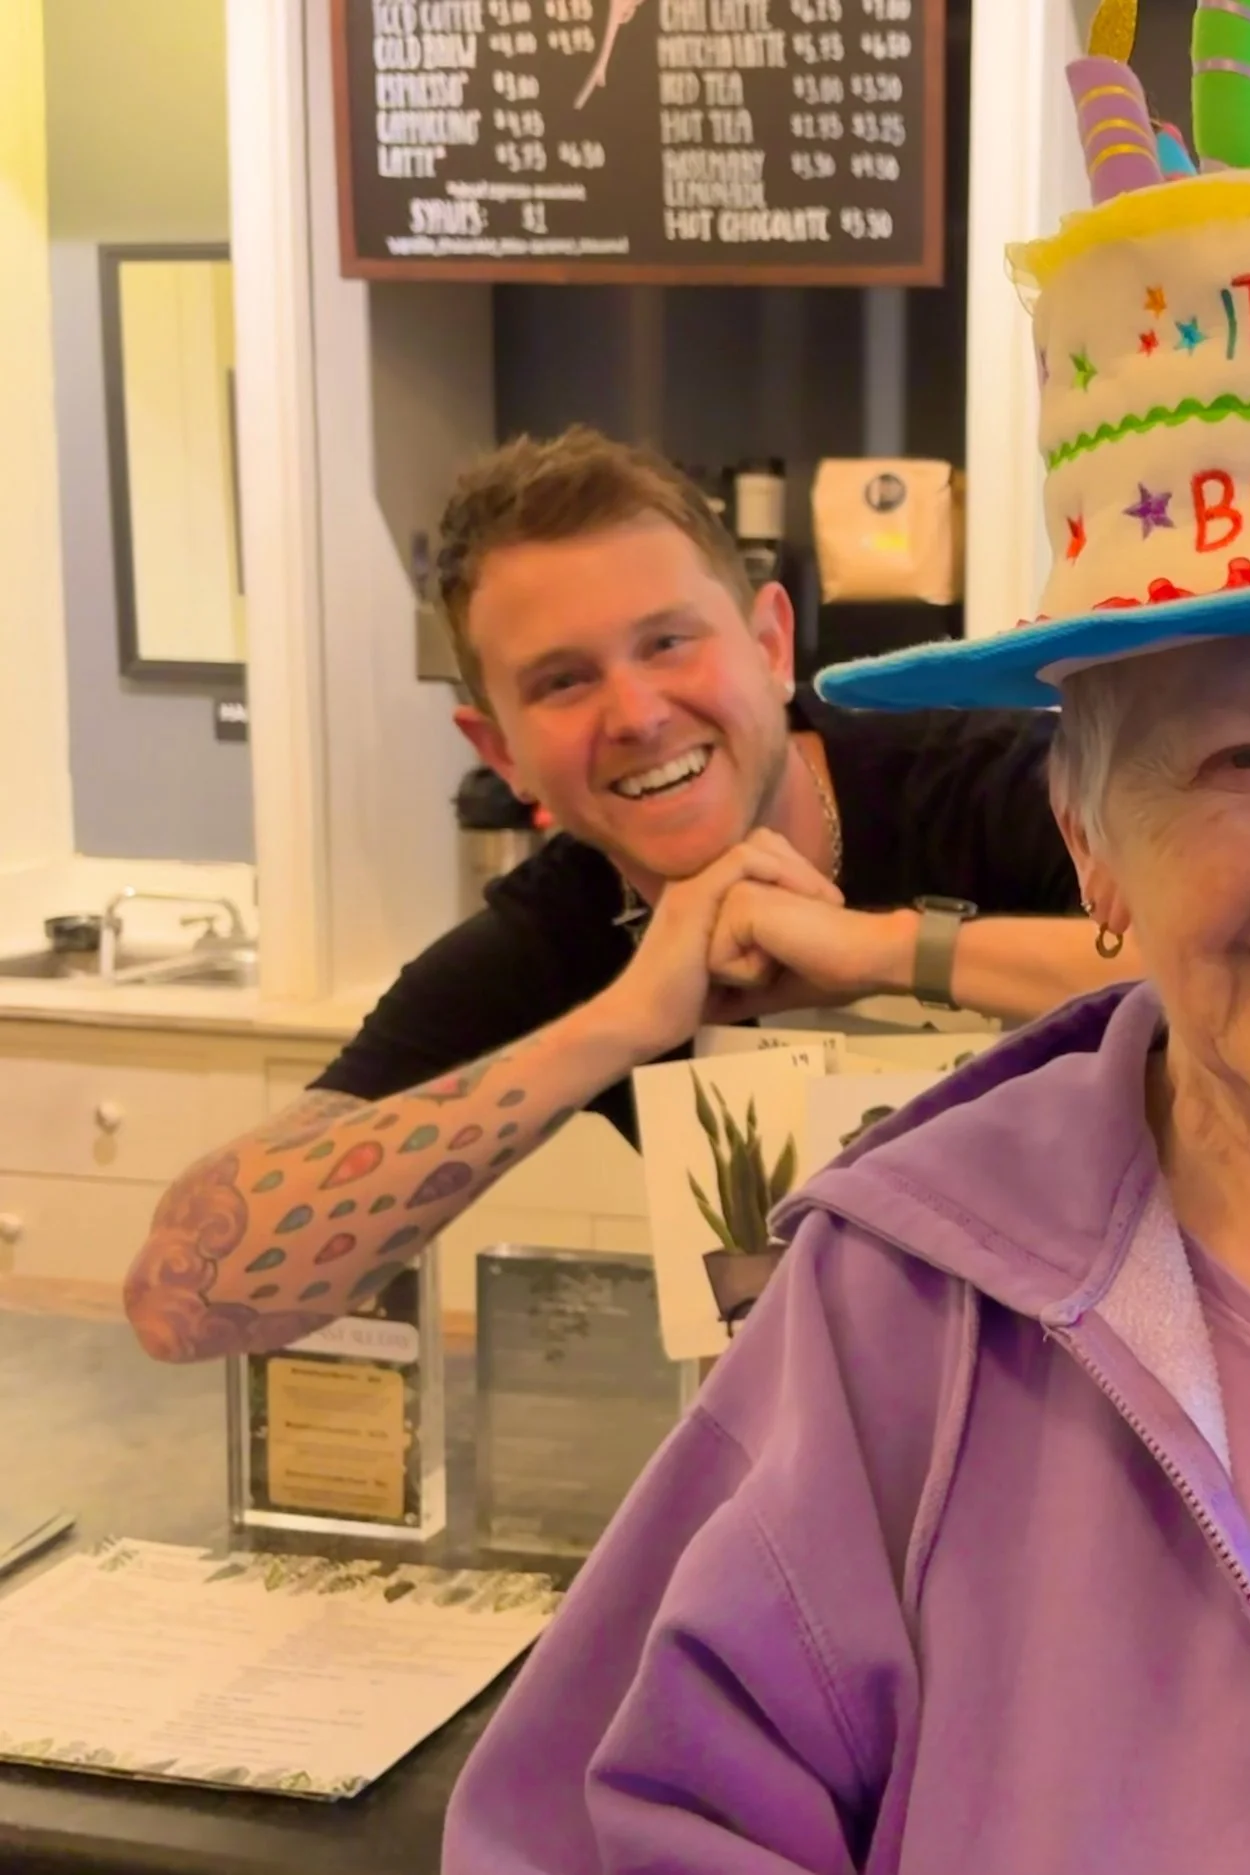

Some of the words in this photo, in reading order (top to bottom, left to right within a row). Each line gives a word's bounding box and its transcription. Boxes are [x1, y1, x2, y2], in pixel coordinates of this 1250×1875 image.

[373, 34, 421, 69] COLD
[422, 33, 477, 68] BREW
[702, 70, 744, 106] TEA
[660, 109, 703, 144] HOT
[708, 108, 754, 144] TEA
[664, 207, 714, 241] HOT
[717, 206, 830, 243] CHOCOLATE
